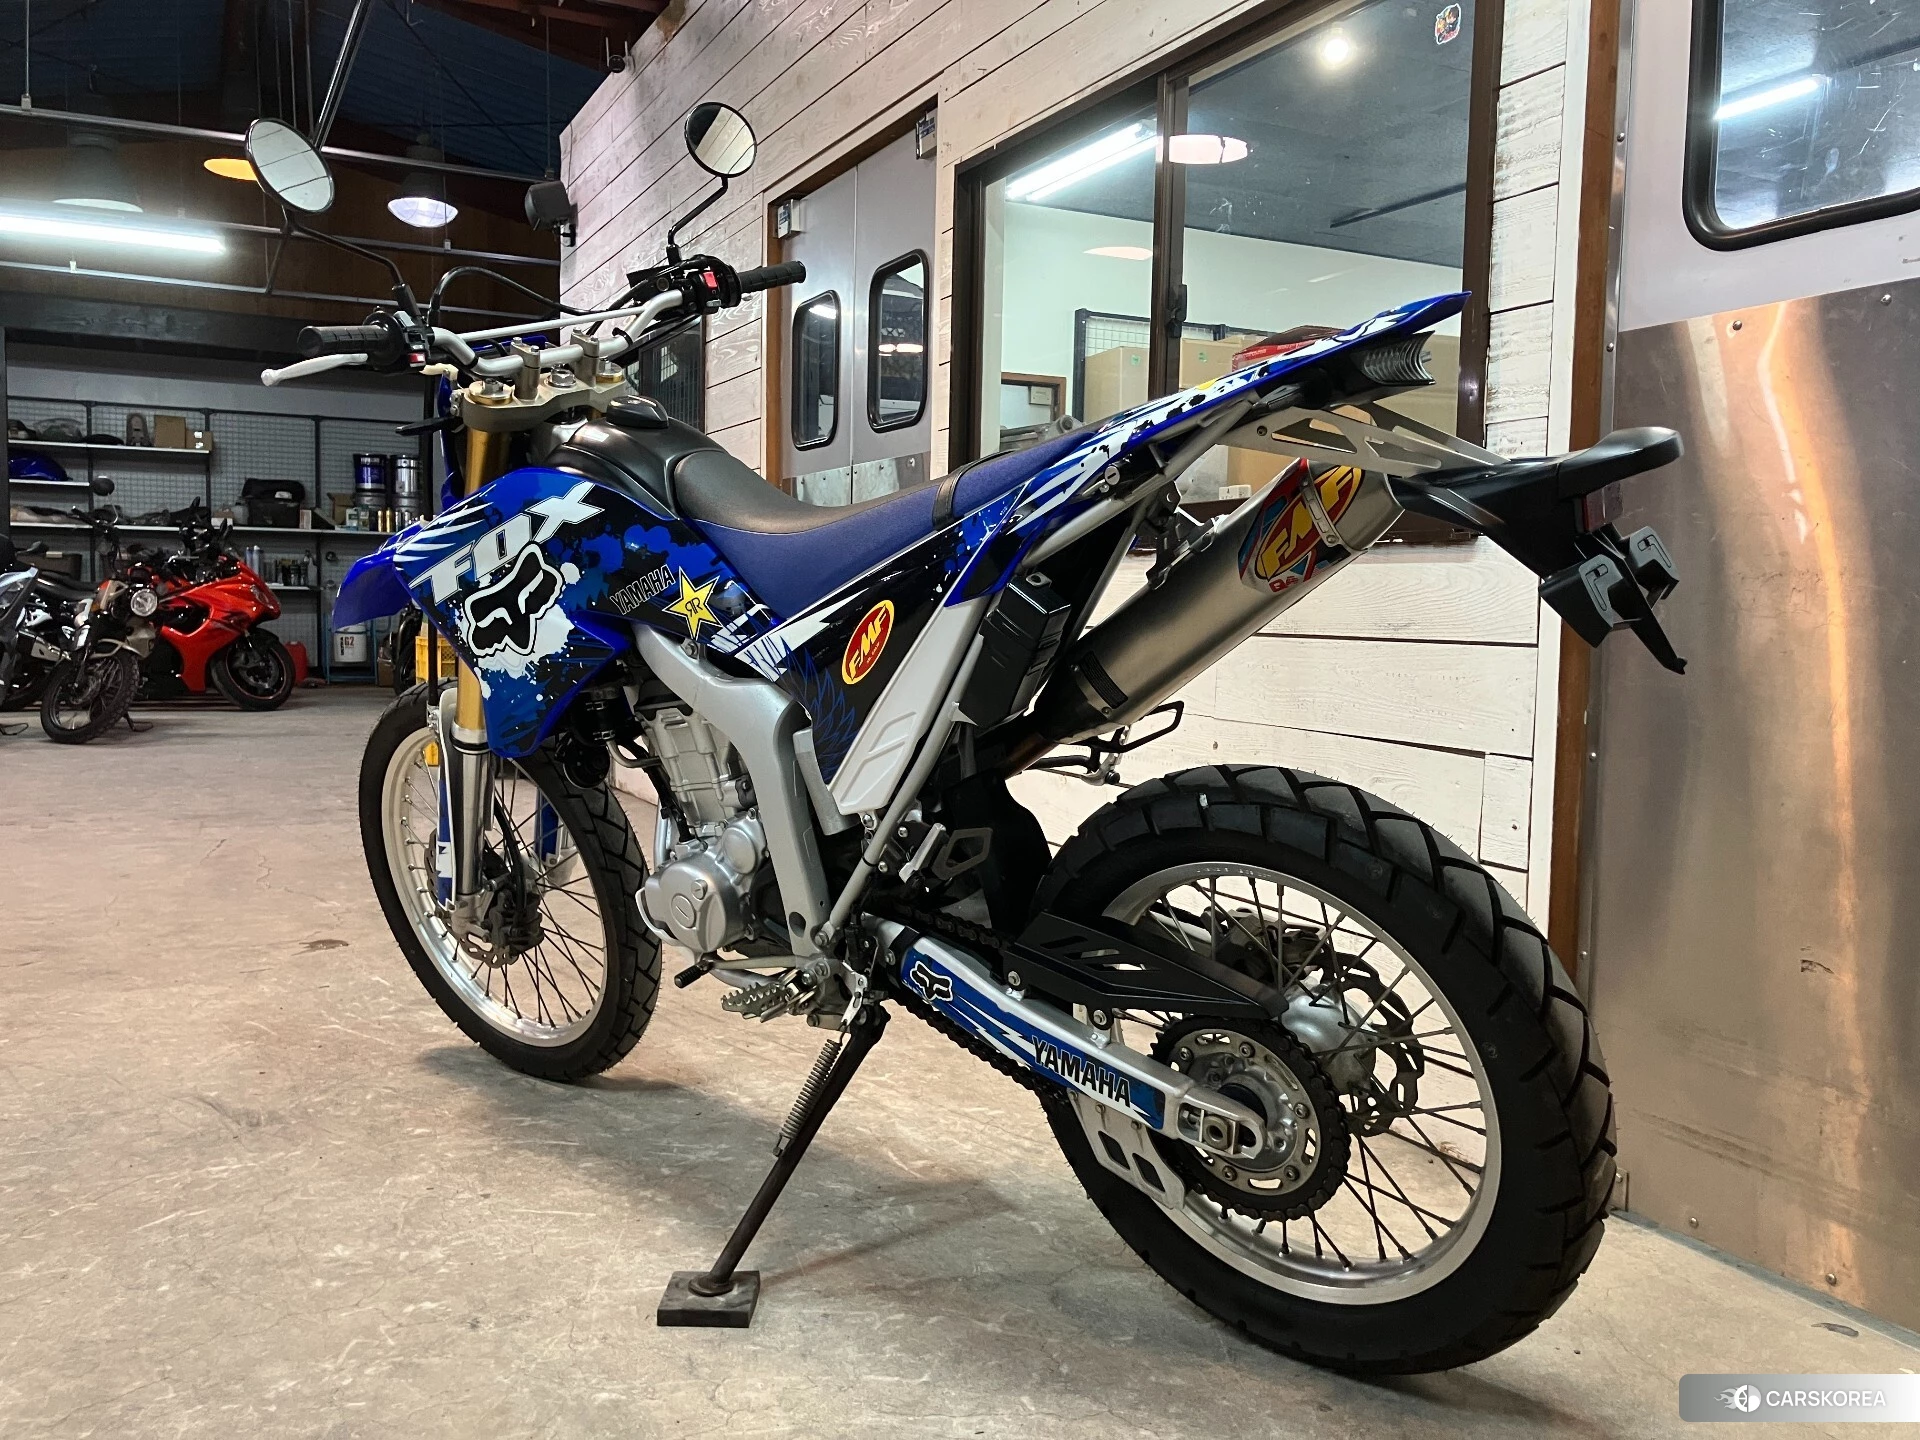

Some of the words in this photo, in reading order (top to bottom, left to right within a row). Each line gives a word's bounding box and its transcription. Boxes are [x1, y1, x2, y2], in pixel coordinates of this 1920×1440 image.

[408, 481, 606, 607] FOX
[609, 564, 677, 616] YAMAHA
[848, 604, 888, 681] FMF
[1031, 1035, 1131, 1108] YAMAHA
